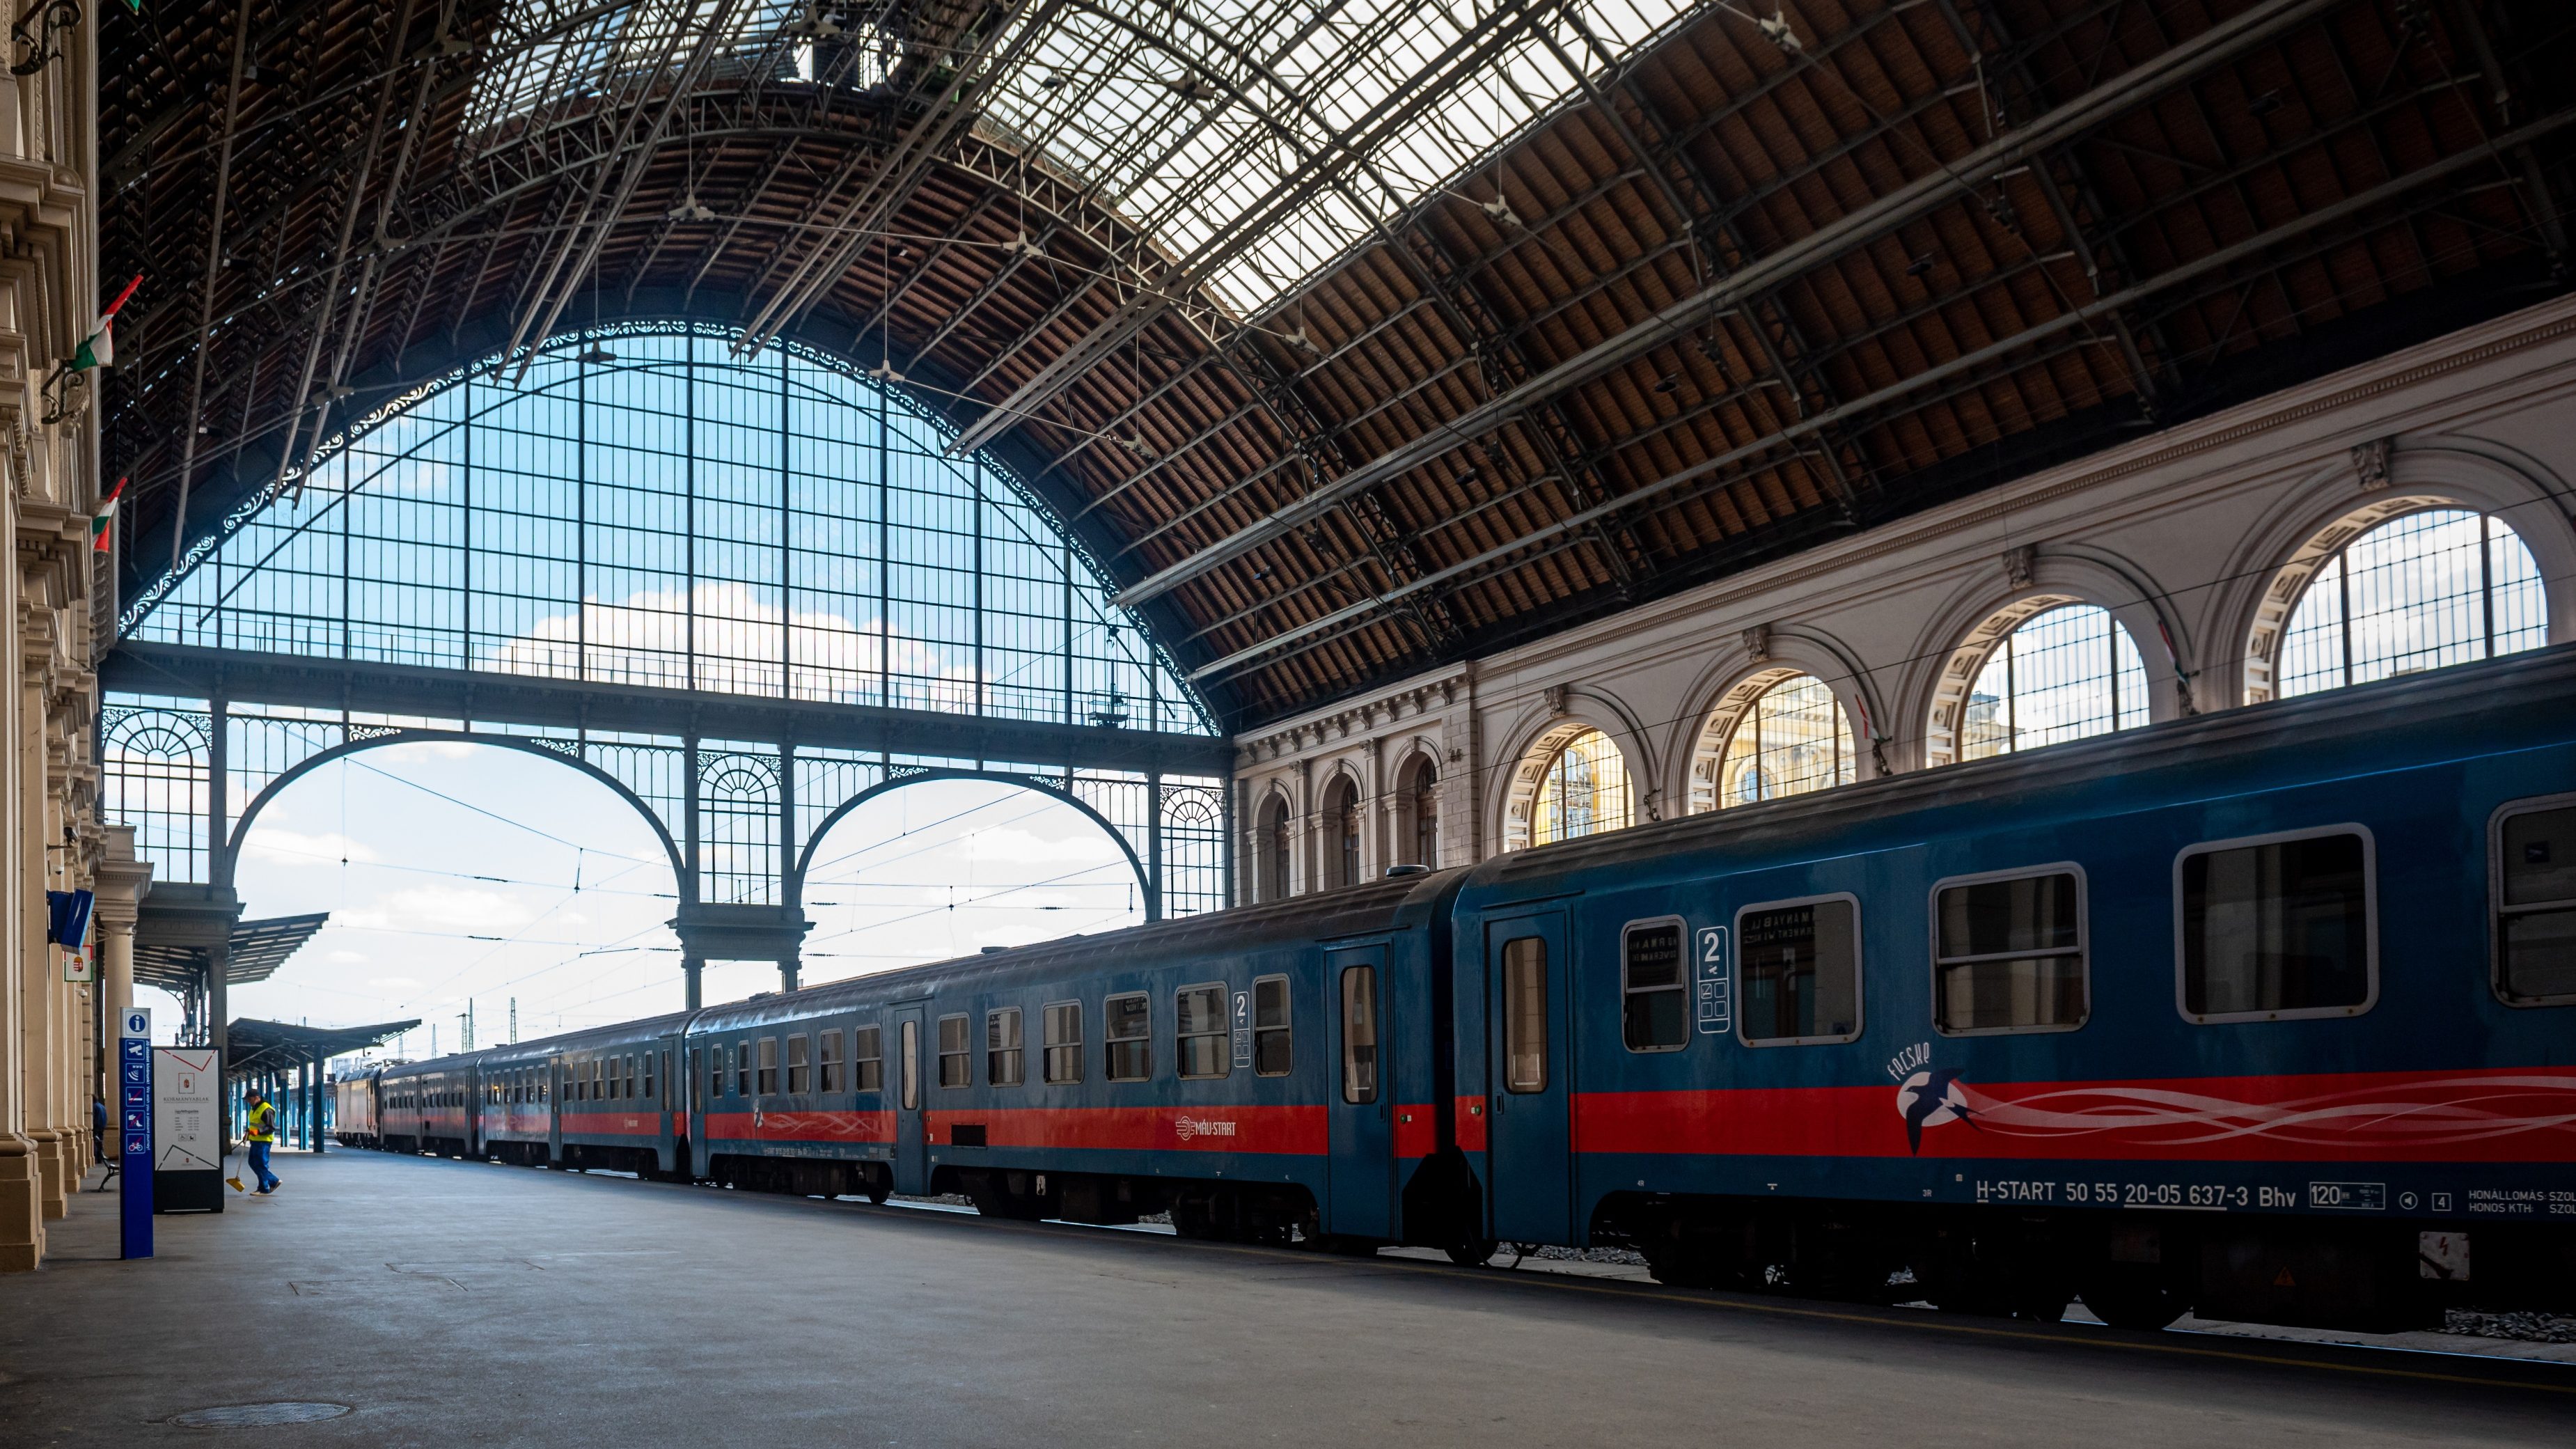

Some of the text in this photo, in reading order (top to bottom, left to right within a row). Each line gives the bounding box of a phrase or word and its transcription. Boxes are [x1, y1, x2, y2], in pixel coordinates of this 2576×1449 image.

[1704, 932, 1720, 962] 2
[1236, 995, 1246, 1017] 2
[729, 1051, 733, 1063] 2
[1922, 1189, 1933, 1198] 3R
[1976, 1180, 2297, 1207] H-START 50 55 20-05 637-3 Bhv
[2311, 1185, 2341, 1205] 120
[2438, 1196, 2446, 1208] 4
[2469, 1203, 2506, 1213] HONOS
